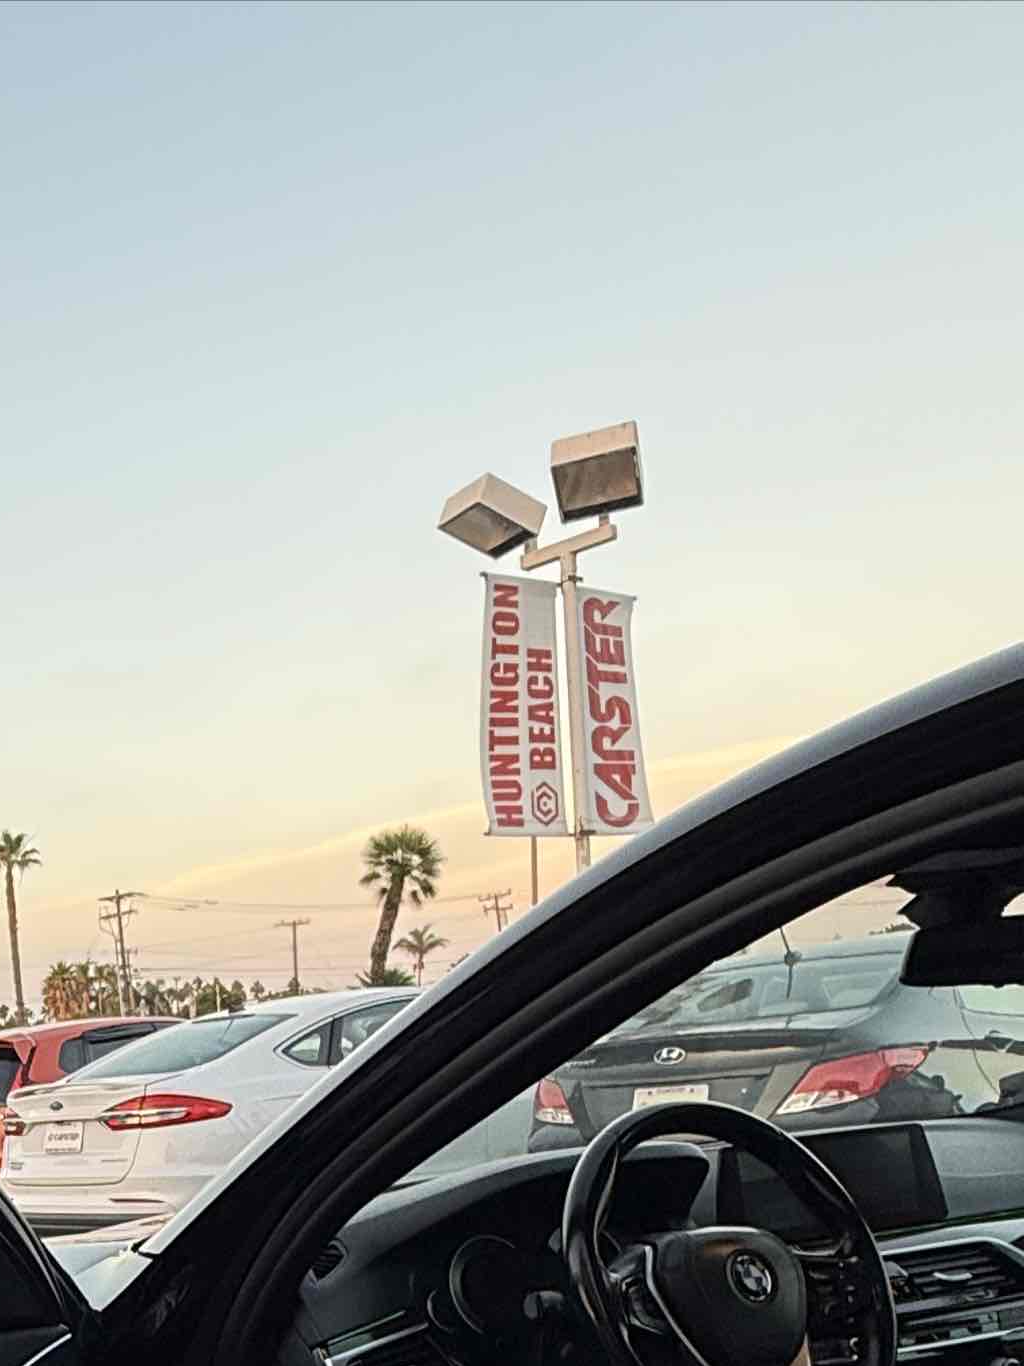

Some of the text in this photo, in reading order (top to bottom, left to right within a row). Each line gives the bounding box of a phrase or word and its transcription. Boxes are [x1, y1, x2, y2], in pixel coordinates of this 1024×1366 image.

[488, 583, 524, 828] HUNTINGTON
[527, 647, 557, 771] BEACH
[583, 596, 640, 828] CARSTER
